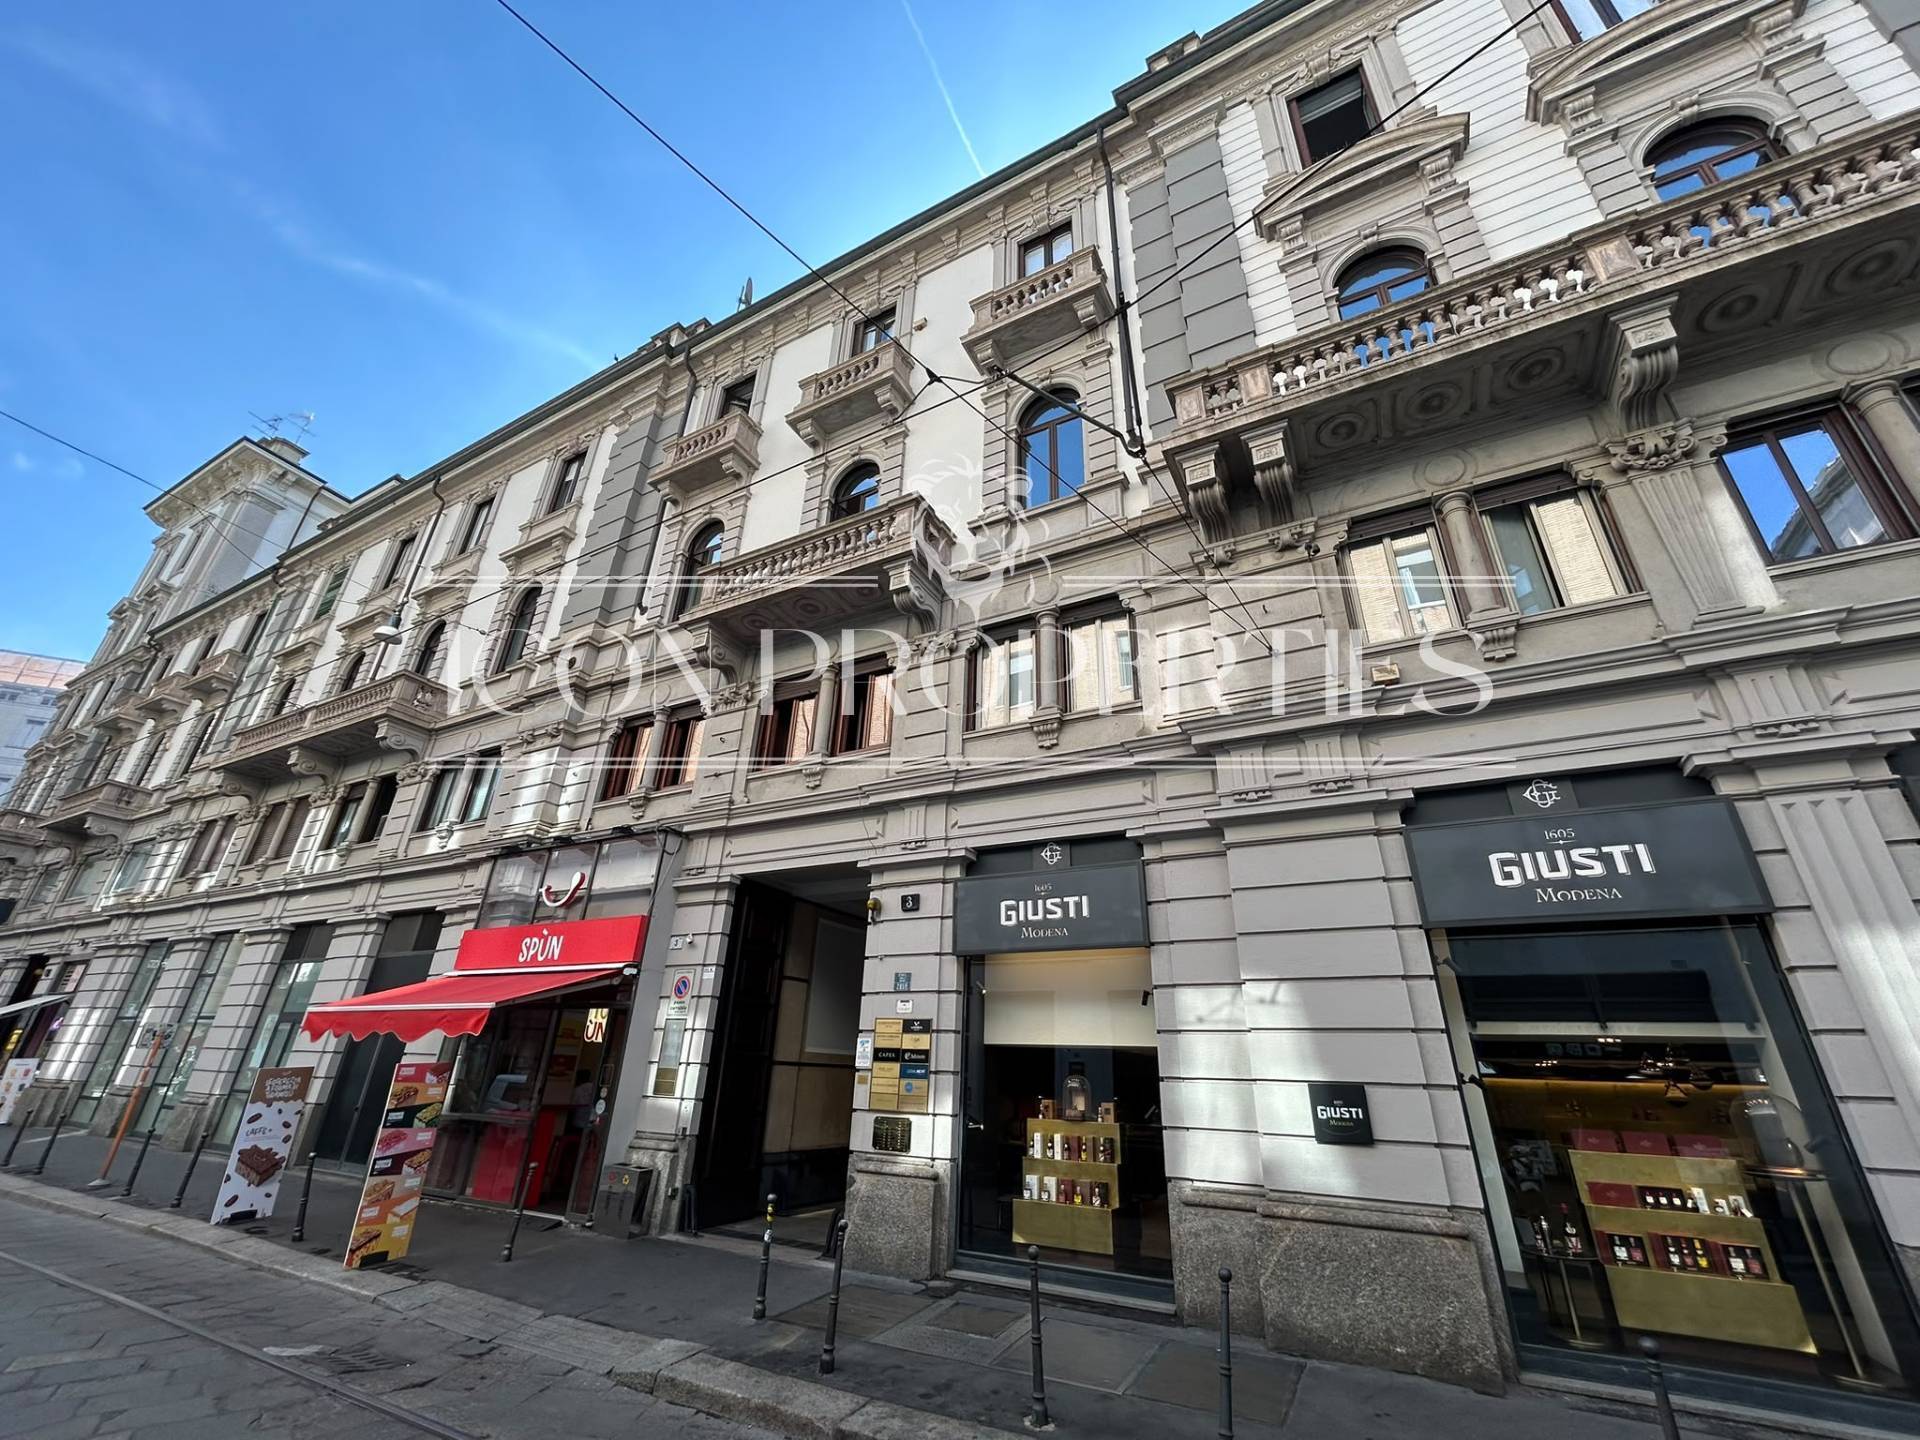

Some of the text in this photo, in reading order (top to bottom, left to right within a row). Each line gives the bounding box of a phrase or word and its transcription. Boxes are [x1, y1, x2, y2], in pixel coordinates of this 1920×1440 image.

[1544, 828, 1575, 841] 1605
[1487, 843, 1657, 889] GIUSTI
[905, 895, 913, 909] 3
[1000, 894, 1090, 927] GIUSTI
[521, 930, 563, 962] SPÙN
[1316, 1104, 1364, 1120] GIUSTI
